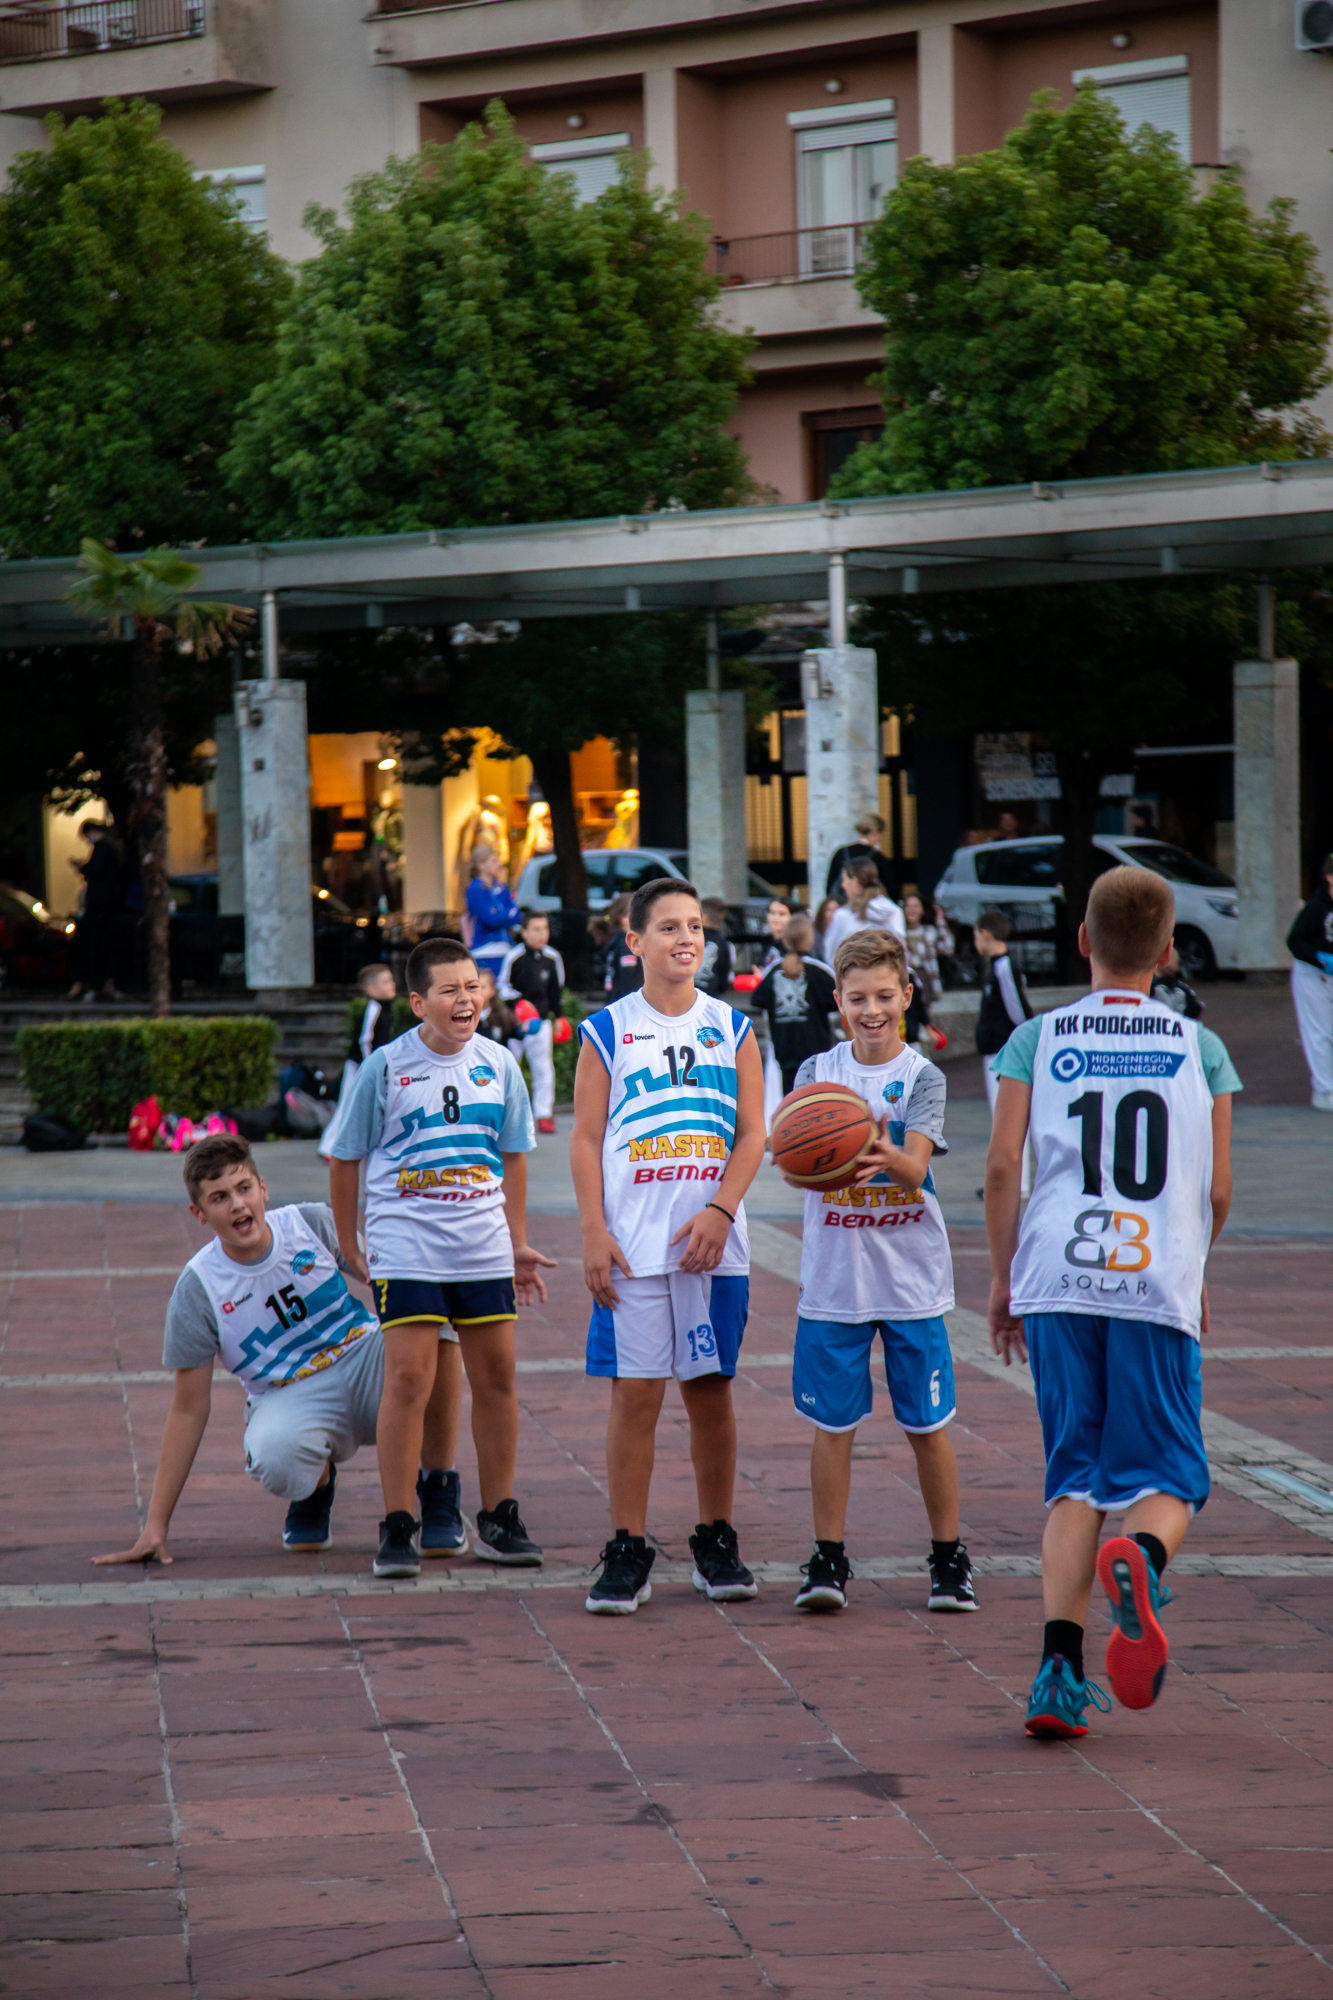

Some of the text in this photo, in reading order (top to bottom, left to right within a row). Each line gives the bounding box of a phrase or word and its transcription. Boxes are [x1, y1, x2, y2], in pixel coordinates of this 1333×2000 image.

[1055, 1015, 1184, 1038] KK PODGORICA
[663, 1045, 698, 1087] 12
[1091, 1054, 1173, 1065] HIDROENERGIJA
[1091, 1064, 1166, 1075] MONTENEGRO
[442, 1085, 461, 1124] 8
[1067, 1089, 1169, 1201] 10
[634, 1165, 726, 1184] BEMA
[824, 1210, 925, 1228] BEMAX
[376, 1278, 388, 1313] 7
[1061, 1273, 1148, 1295] SOLAR
[265, 1283, 308, 1330] 15
[687, 1324, 717, 1362] 13
